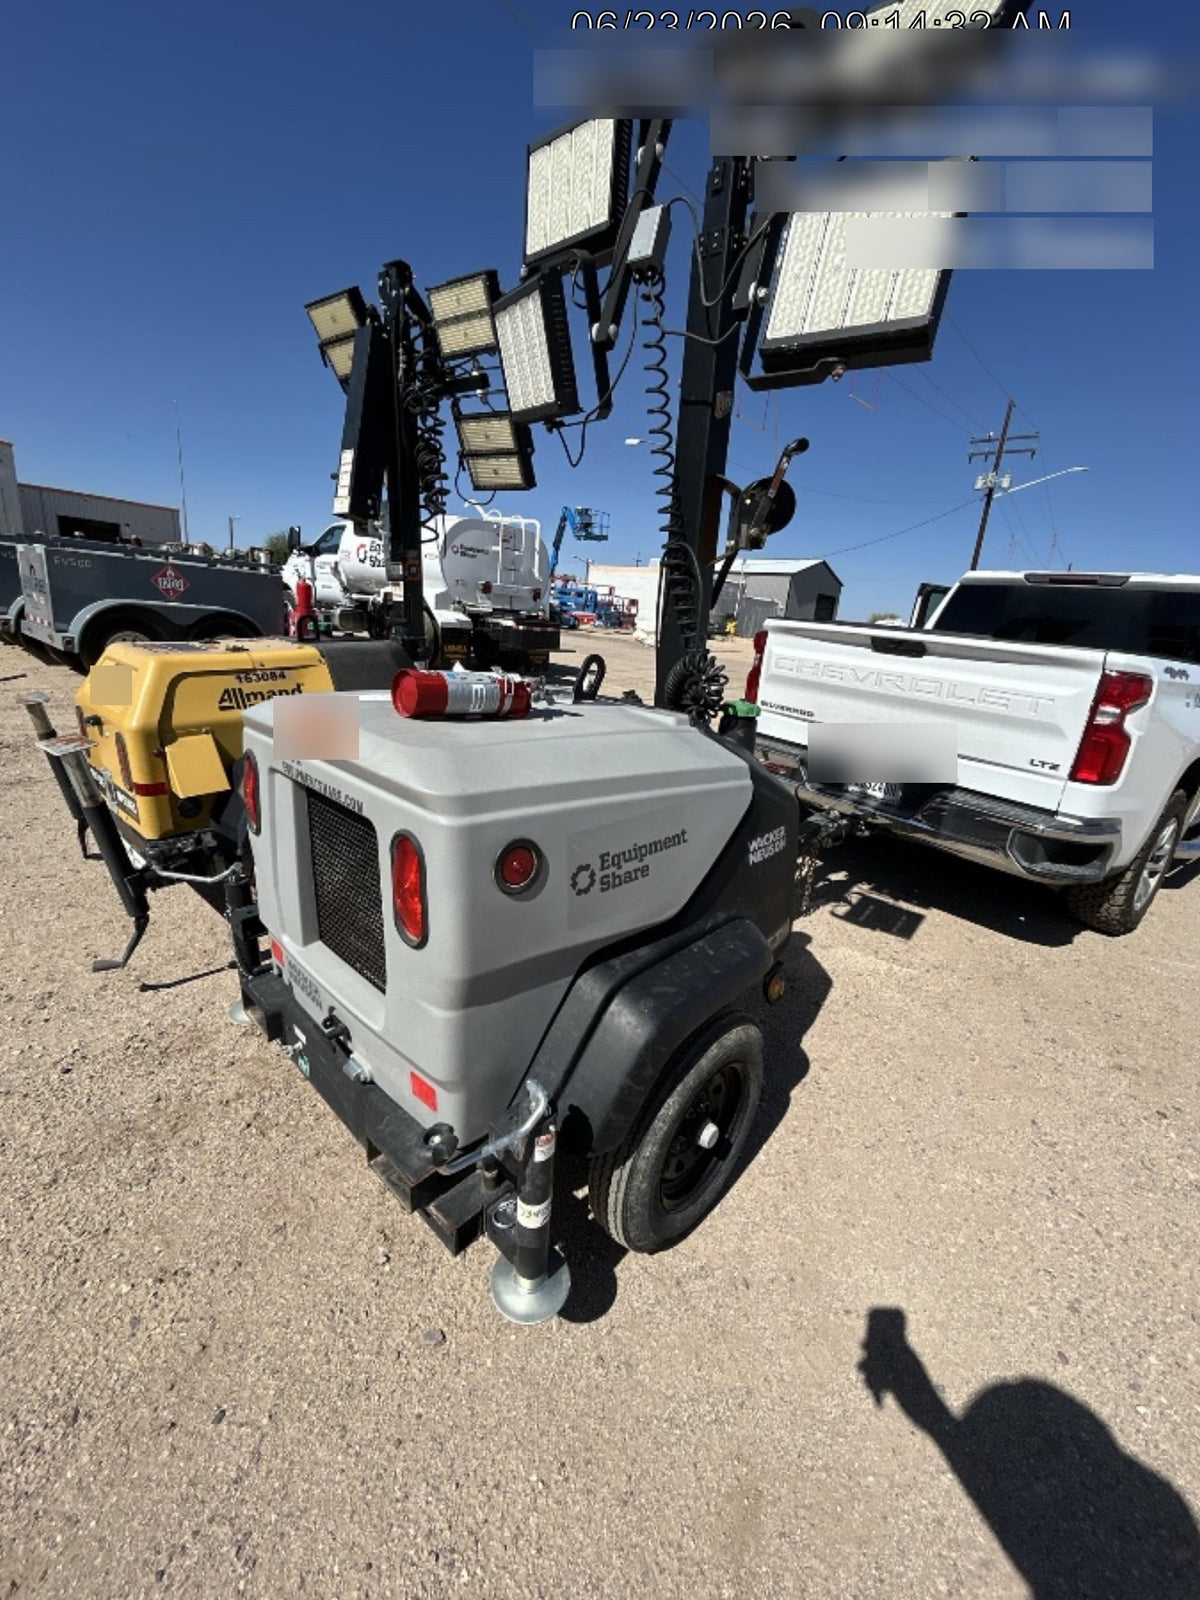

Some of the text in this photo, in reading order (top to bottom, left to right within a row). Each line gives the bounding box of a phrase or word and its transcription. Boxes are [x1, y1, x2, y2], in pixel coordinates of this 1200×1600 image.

[235, 671, 288, 684] 163084
[774, 655, 1055, 716] CHEVROLET
[760, 700, 815, 718] SILVERADO
[1029, 758, 1060, 770] LTZ
[599, 828, 688, 871] Equipment
[748, 826, 786, 852] WACKER
[749, 840, 787, 866] NEUSON
[600, 864, 650, 893] Share
